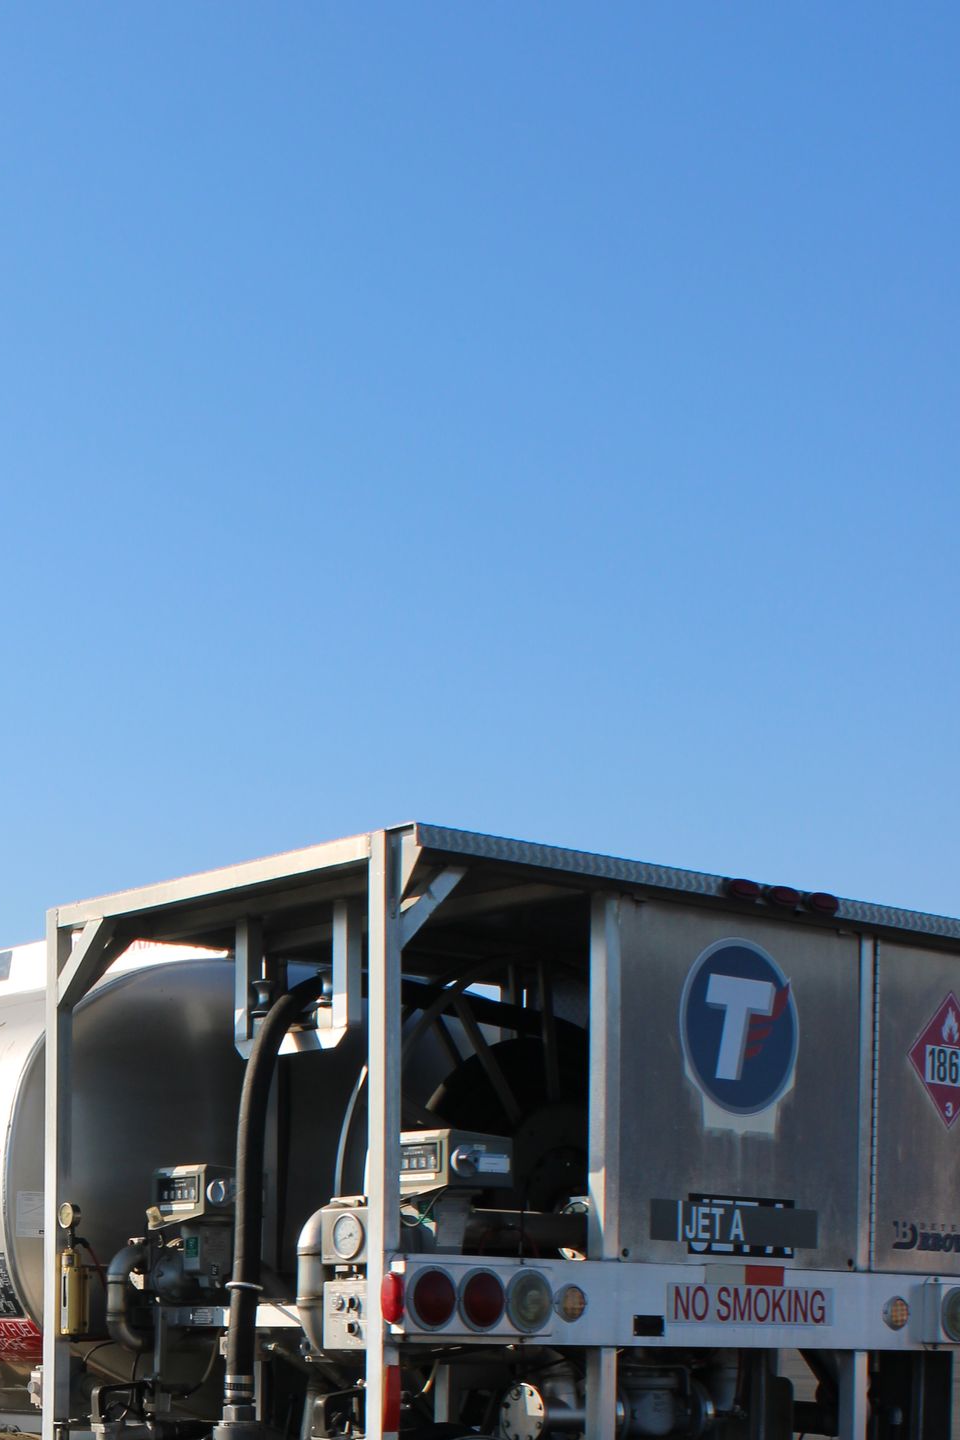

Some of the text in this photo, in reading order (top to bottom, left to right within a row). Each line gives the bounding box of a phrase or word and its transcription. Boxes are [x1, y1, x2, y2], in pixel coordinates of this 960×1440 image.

[944, 1102, 954, 1118] 3
[684, 1206, 745, 1241] JET A
[674, 1285, 825, 1324] NO SMOKING
[5, 1322, 41, 1337] FUEL
